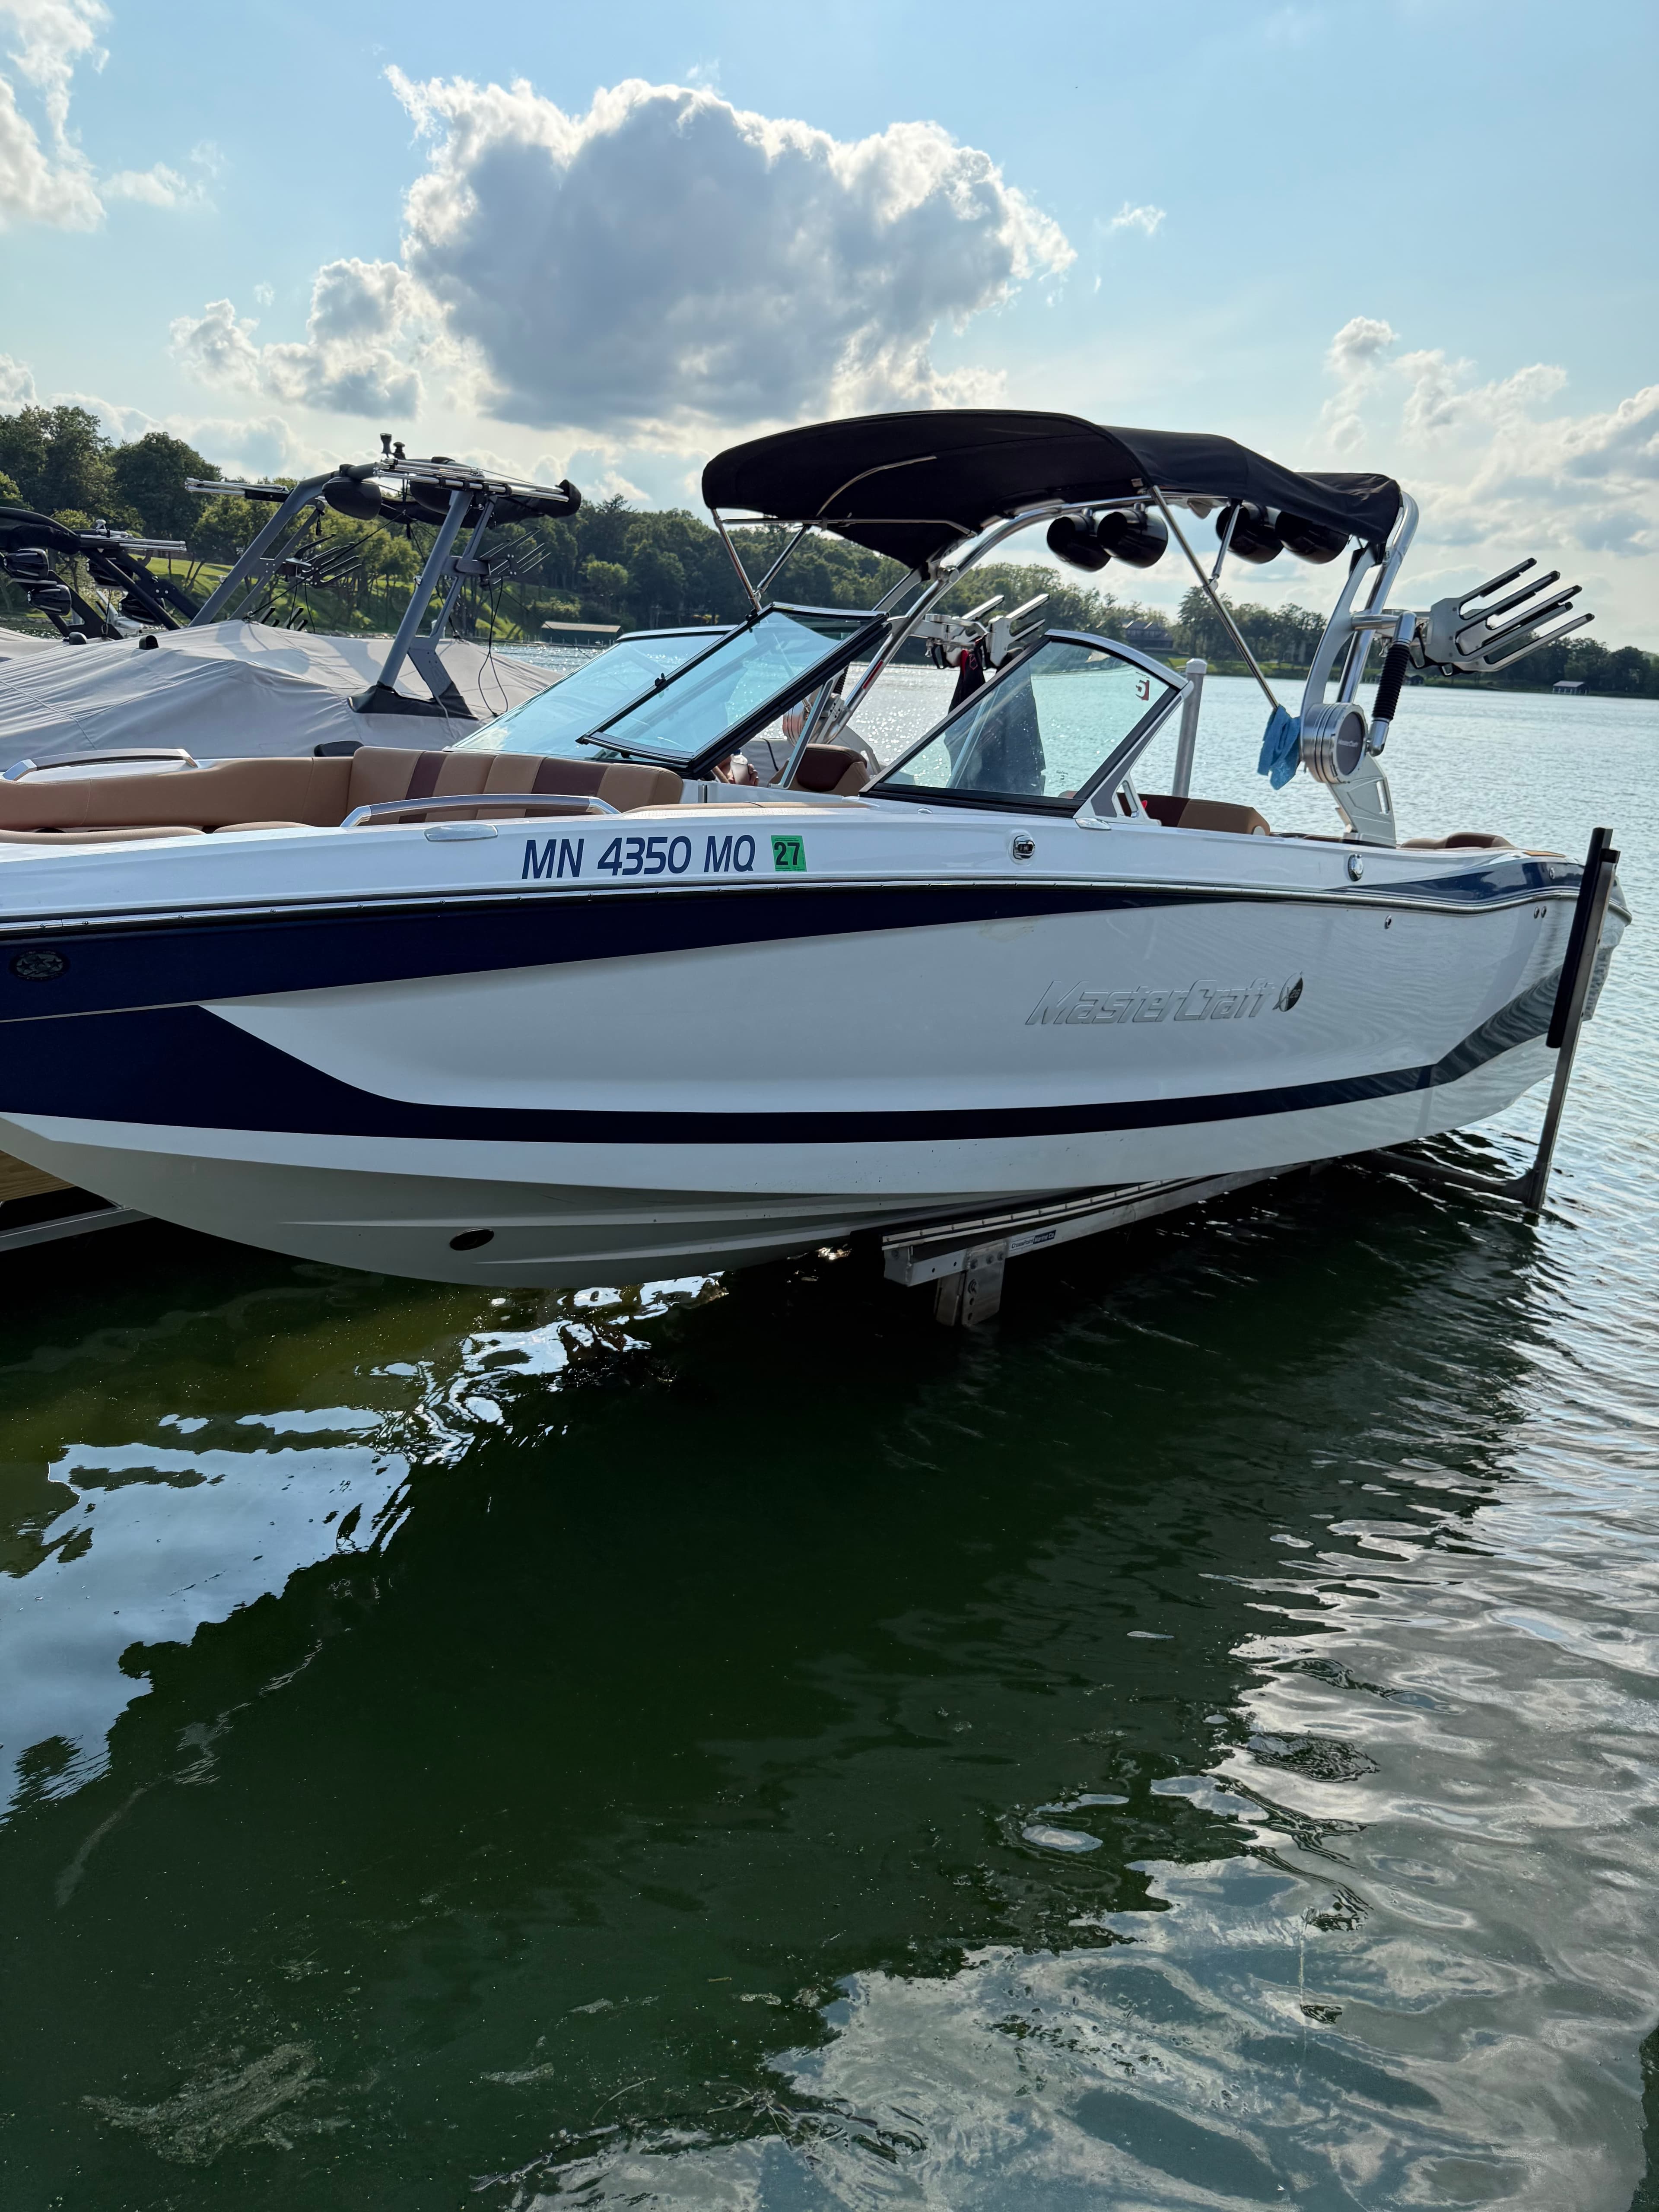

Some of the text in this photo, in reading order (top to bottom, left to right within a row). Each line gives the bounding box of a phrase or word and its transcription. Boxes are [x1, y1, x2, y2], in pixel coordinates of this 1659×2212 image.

[521, 835, 756, 879] MN 4350 MQ
[774, 842, 800, 865] 27
[1025, 978, 1275, 1025] MasterCraft
